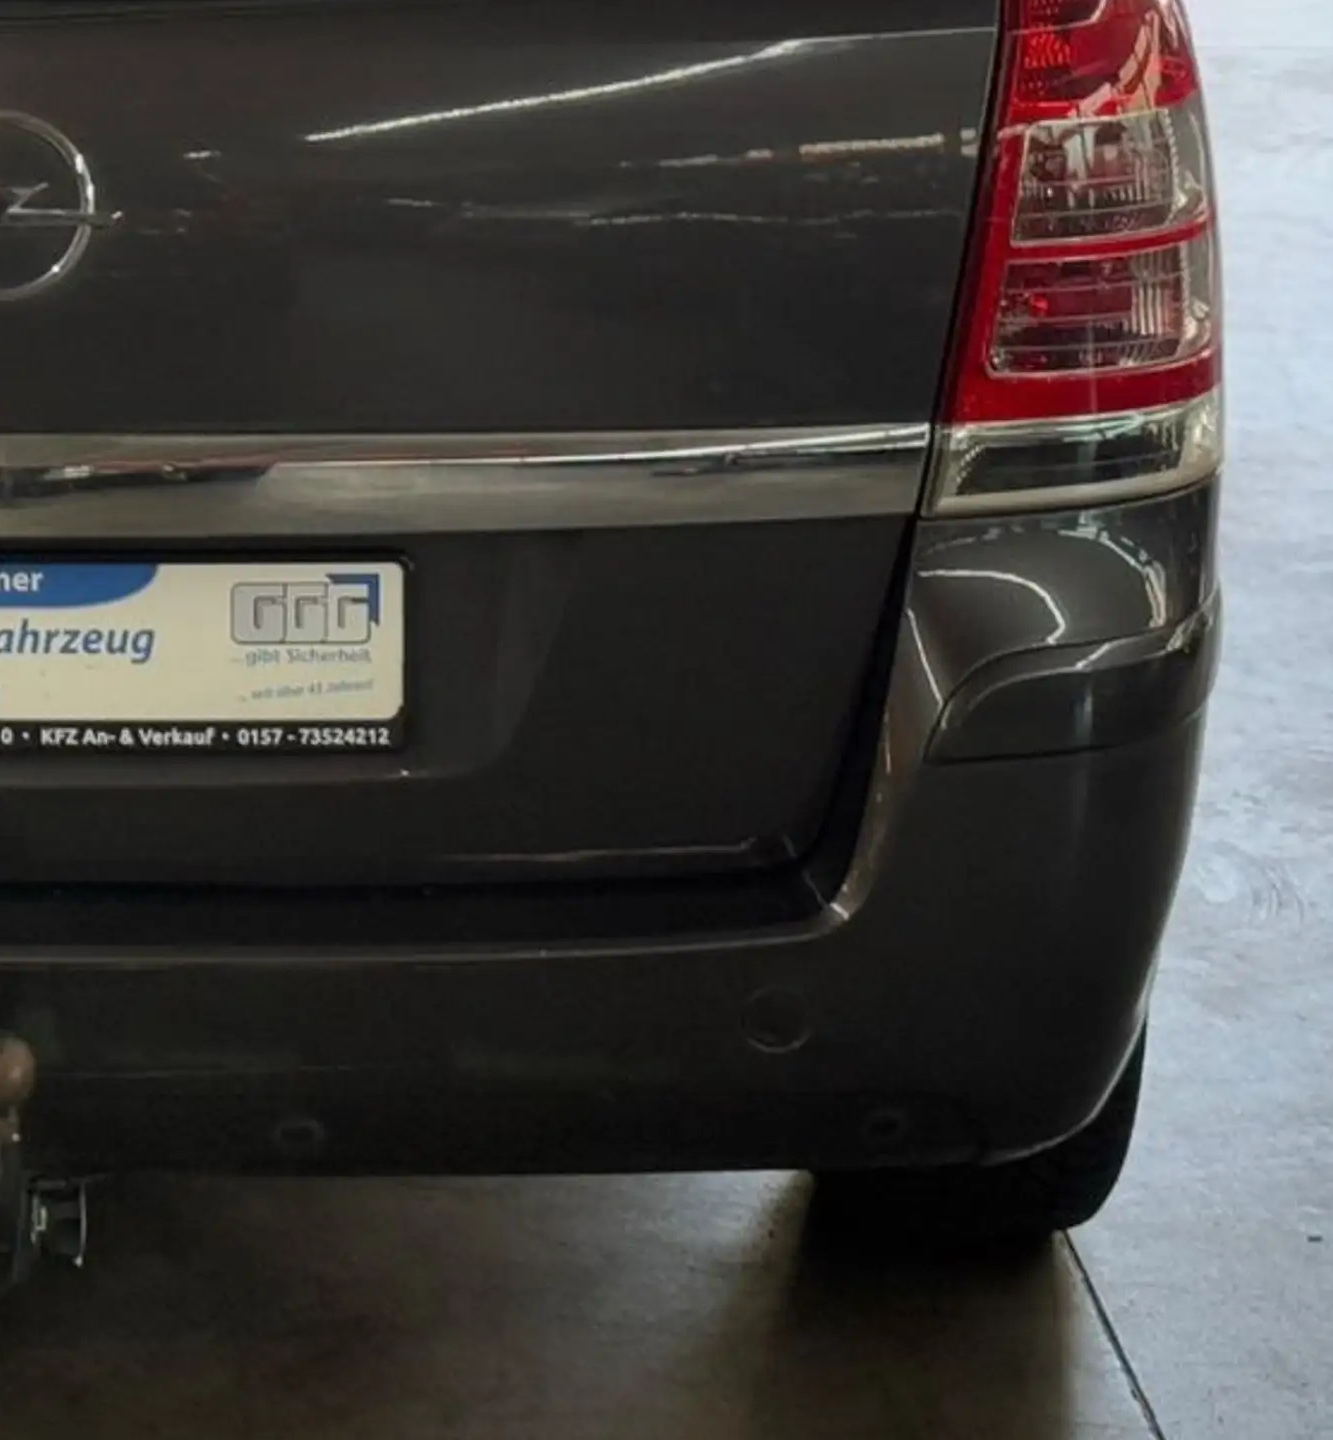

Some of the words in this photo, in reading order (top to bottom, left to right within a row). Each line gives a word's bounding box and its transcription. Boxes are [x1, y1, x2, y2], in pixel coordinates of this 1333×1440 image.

[41, 729, 78, 745] KFZ
[141, 728, 216, 747] Verkauf
[237, 729, 283, 746] 0157
[300, 729, 391, 746] 73524212
